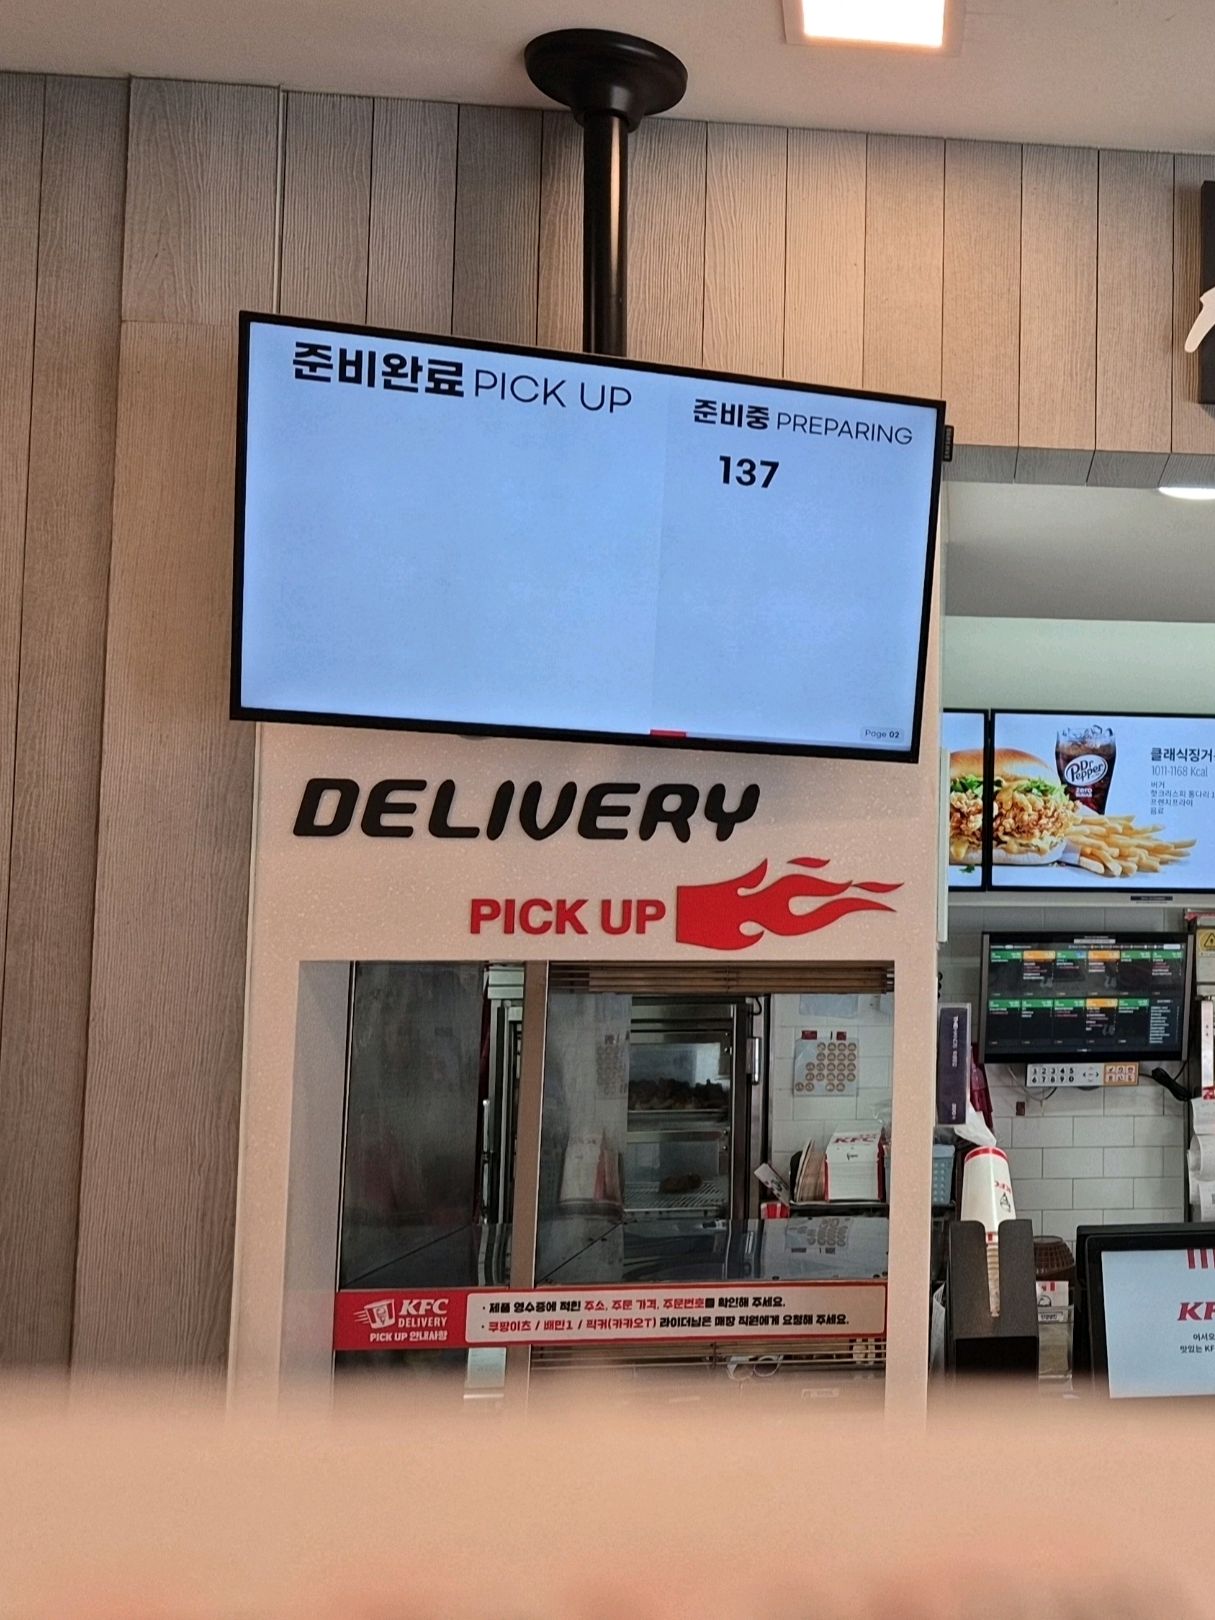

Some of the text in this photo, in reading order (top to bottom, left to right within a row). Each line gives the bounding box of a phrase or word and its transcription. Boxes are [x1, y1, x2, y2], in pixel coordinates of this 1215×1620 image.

[293, 341, 632, 413] 준비완료 PICK UP
[693, 398, 912, 445] 준비중 PREPARING
[719, 455, 779, 488] 137
[865, 729, 900, 739] Page 02
[1070, 763, 1103, 782] Pepper
[1152, 765, 1208, 777] 1011-1168 Kcal
[293, 777, 760, 842] DELIVERY
[470, 897, 667, 935] PICK UP
[399, 1298, 449, 1315] KFC
[489, 1296, 786, 1314] 제품 영수증에 적힌 주소, 주문 가격, 주문번호를 확인해 주세요.
[398, 1316, 447, 1329] DELIVERY
[489, 1320, 531, 1332] 쿠팡이츠
[544, 1319, 573, 1331] 배민1
[586, 1318, 657, 1331] 픽커(카카오T)
[659, 1316, 712, 1328] 라이더님은
[715, 1315, 734, 1327] 매장
[738, 1314, 780, 1327] 직원에게
[782, 1314, 813, 1326] 요청해
[816, 1313, 849, 1326] 주세요.
[370, 1331, 448, 1342] PICK UP 안내사항
